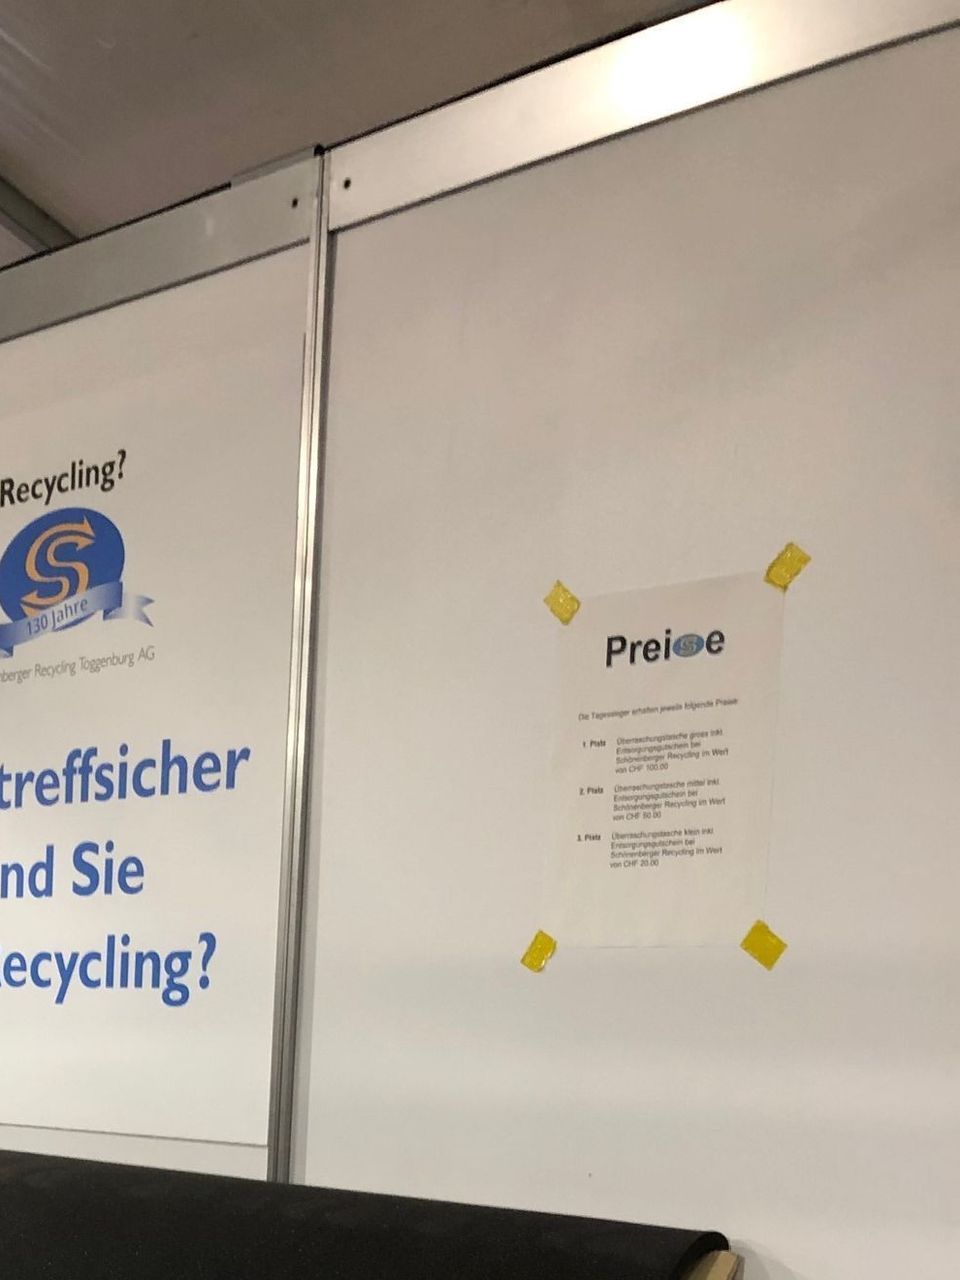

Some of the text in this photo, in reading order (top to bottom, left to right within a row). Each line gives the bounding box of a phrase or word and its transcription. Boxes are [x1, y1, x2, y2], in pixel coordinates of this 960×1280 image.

[0, 449, 126, 507] Recycling?
[27, 597, 88, 635] 130 Jahre
[34, 659, 76, 678] Recycling
[79, 650, 134, 674] Toggenburg
[137, 645, 155, 661] AG
[684, 701, 714, 710] folgende
[590, 740, 606, 748] Platz
[615, 748, 729, 765] Schönenberger Recycling im Wert
[628, 764, 643, 773] CHF
[646, 763, 668, 772] 100.00
[587, 787, 604, 795] Platz
[613, 802, 662, 812] Schönenberger
[664, 799, 697, 809] Recycling
[709, 797, 725, 805] Wert
[626, 812, 641, 821] CHF
[684, 828, 699, 836] klein
[584, 834, 601, 842] Platz
[685, 838, 695, 846] bei
[610, 846, 723, 859] Schönenberger Recycling im Wert
[72, 840, 145, 896] Sie
[623, 859, 638, 868] CHF
